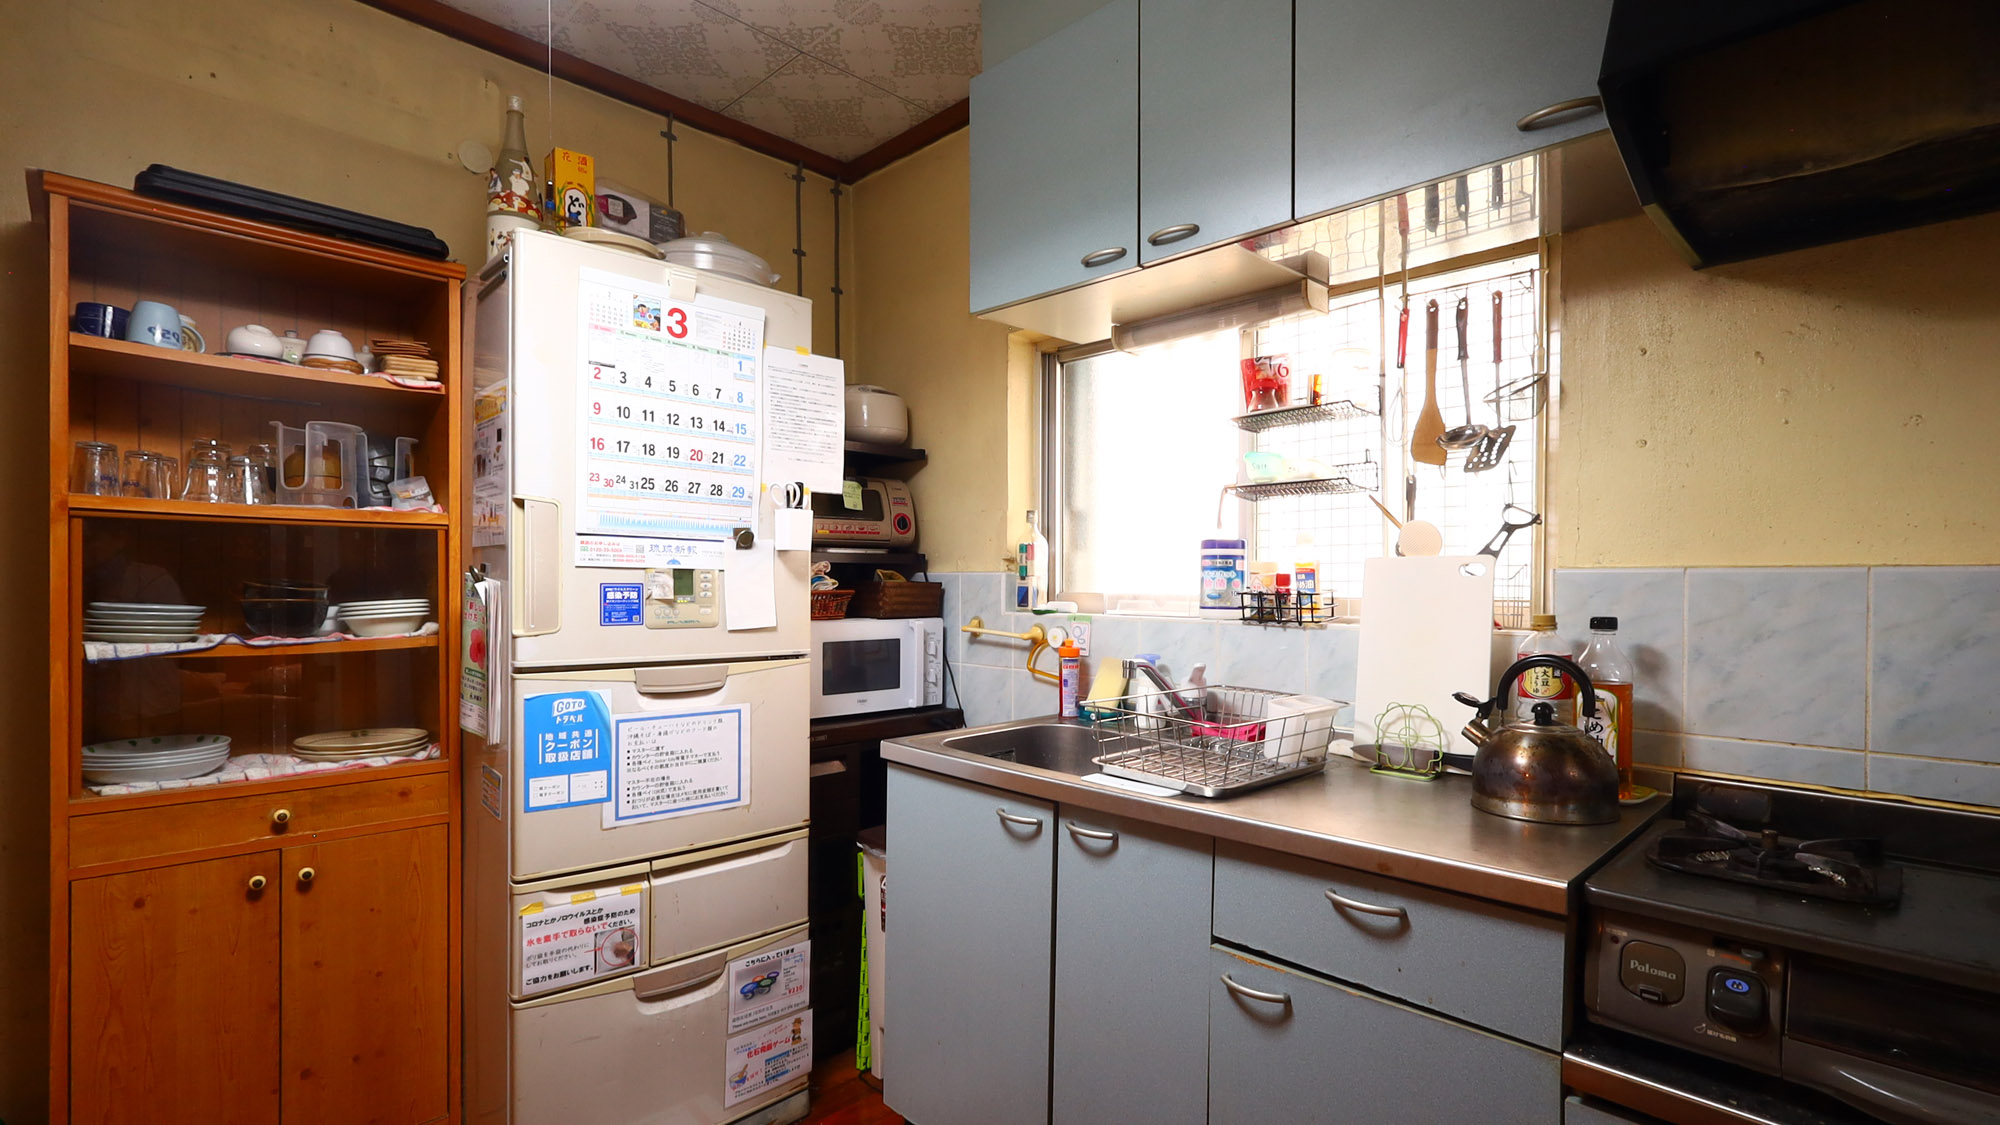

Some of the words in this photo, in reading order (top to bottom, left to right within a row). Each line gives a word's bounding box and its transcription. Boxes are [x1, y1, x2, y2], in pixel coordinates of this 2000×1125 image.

[666, 307, 688, 339] 3
[737, 360, 743, 372] 1
[593, 366, 601, 379] 2
[619, 371, 627, 384] 3
[644, 376, 652, 388] 4
[669, 380, 676, 392] 5
[692, 384, 700, 396] 6
[715, 387, 722, 400] 7
[736, 391, 743, 403] 8
[593, 402, 601, 415] 9
[616, 405, 631, 419] 10
[642, 409, 654, 422] 11
[667, 412, 680, 426] 12
[690, 416, 703, 429] 13
[713, 420, 725, 432] 14
[735, 423, 747, 435] 15
[590, 437, 605, 450] 16
[616, 440, 630, 453] 17
[642, 443, 656, 456] 18
[666, 447, 680, 459] 19
[689, 449, 703, 461] 20
[711, 452, 724, 464] 21
[733, 455, 746, 466] 22
[589, 472, 600, 482] 23
[603, 478, 614, 488] 30
[615, 475, 626, 484] 24
[629, 481, 639, 489] 31
[640, 477, 655, 490] 25
[664, 480, 679, 492] 26
[687, 482, 701, 494] 27
[709, 484, 723, 496] 28
[731, 487, 745, 498] 29
[556, 715, 583, 724] トラベル
[545, 739, 593, 752] クーポン
[526, 908, 603, 928] コロナとかノロウイルスとか
[1630, 959, 1677, 980] Paloma
